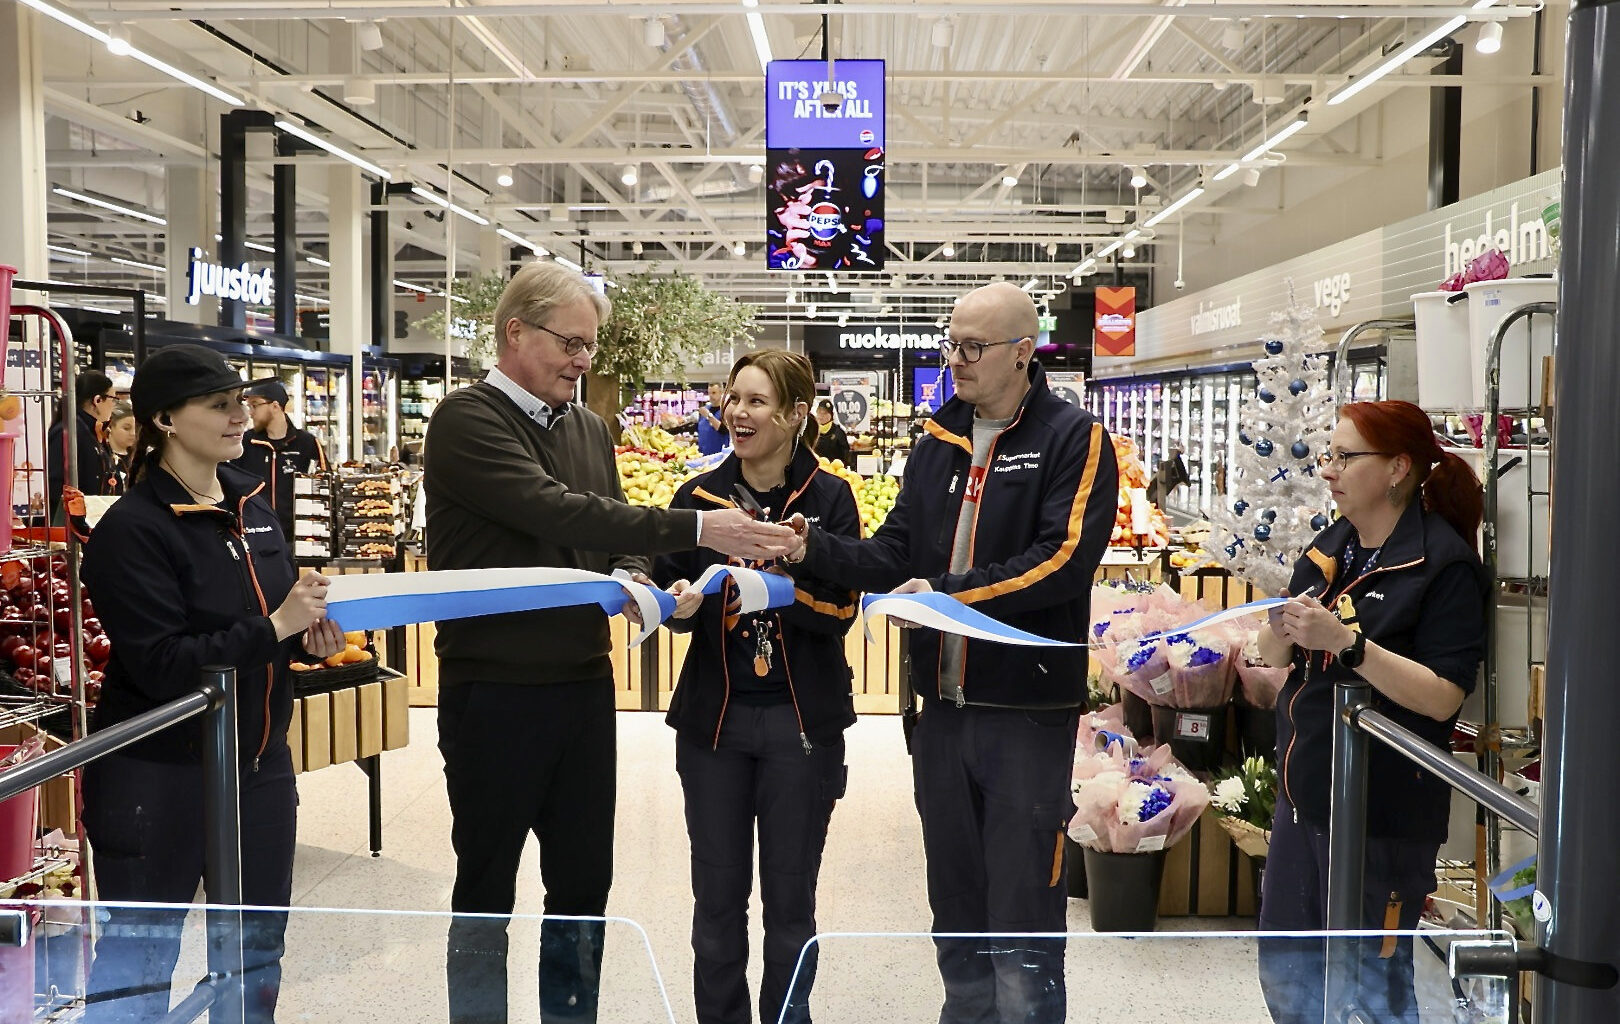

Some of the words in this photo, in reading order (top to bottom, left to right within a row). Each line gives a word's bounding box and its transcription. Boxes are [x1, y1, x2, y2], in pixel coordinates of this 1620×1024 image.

[779, 81, 809, 100] IT'S
[845, 100, 873, 118] ALL
[187, 247, 276, 306] juustot
[1313, 272, 1351, 318] vege
[1191, 722, 1199, 733] 8
